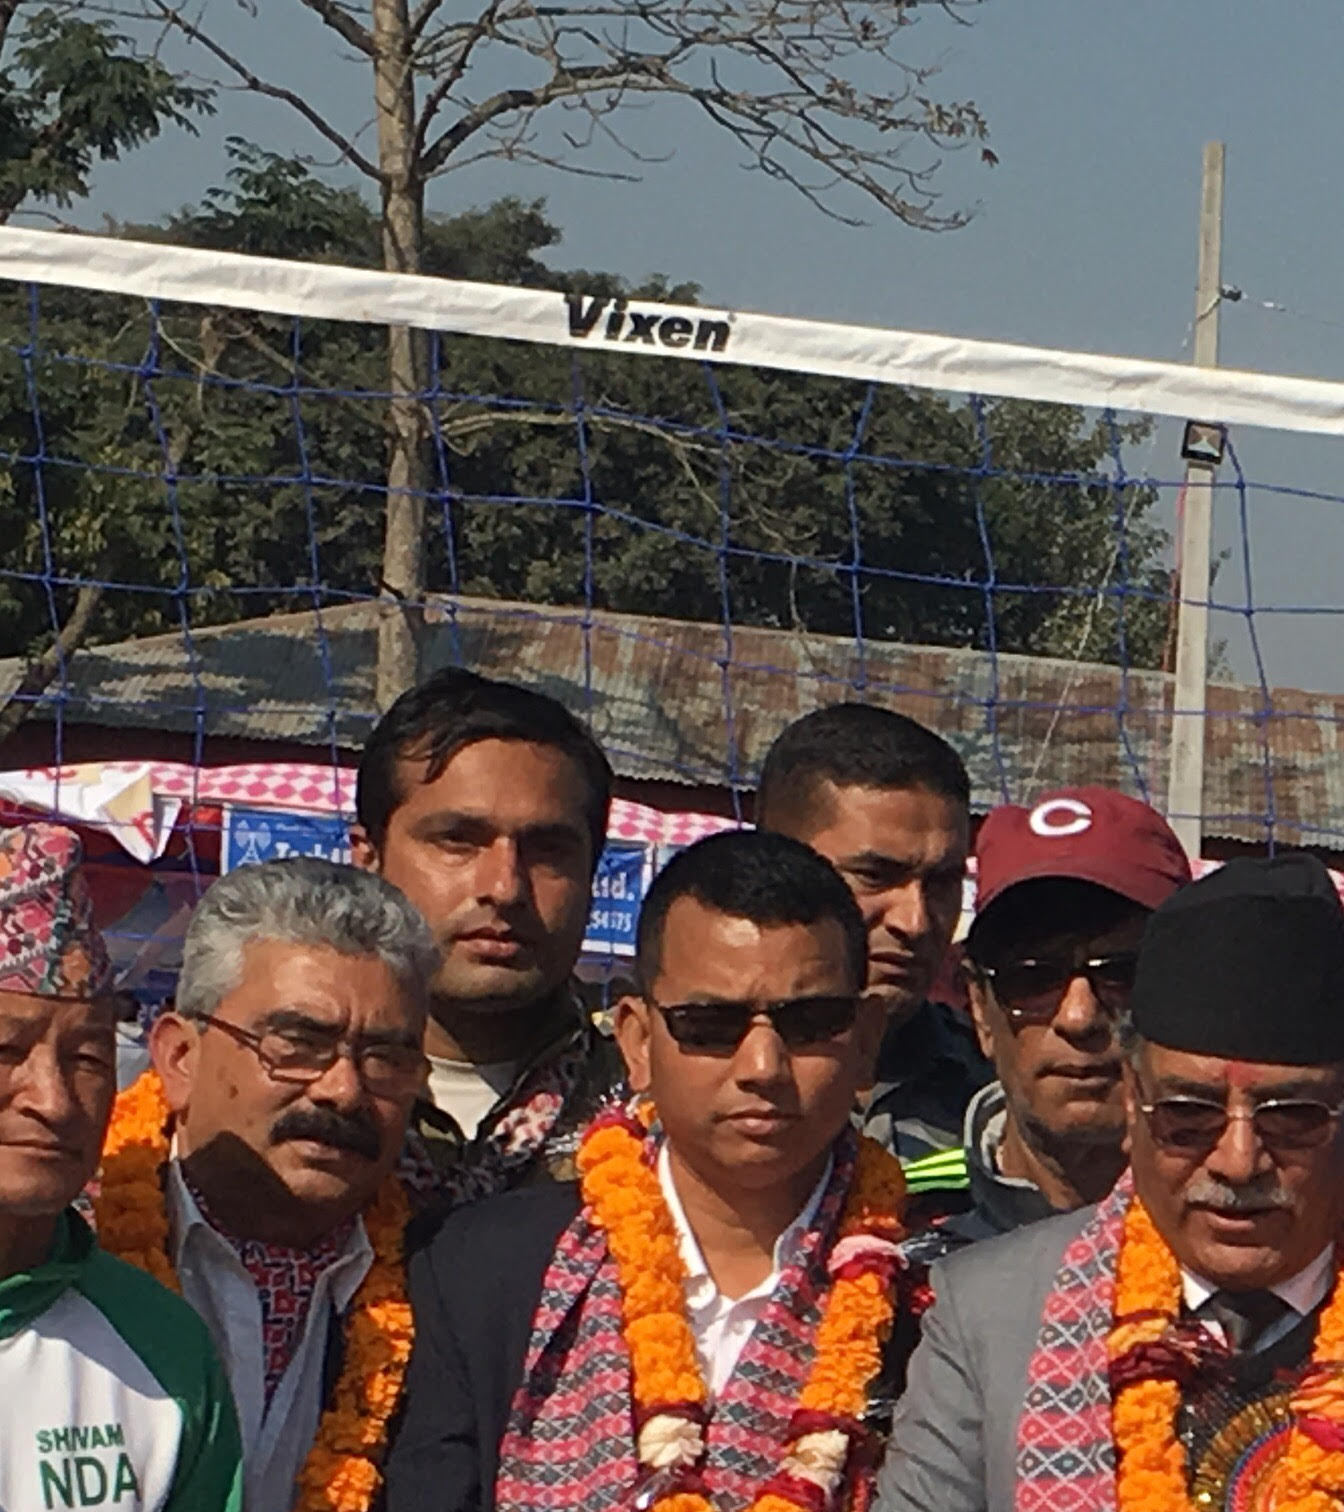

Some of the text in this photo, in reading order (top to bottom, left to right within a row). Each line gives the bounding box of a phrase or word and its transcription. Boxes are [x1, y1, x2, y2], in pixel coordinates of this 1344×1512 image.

[564, 294, 732, 352] Vixen
[1029, 798, 1092, 836] C
[36, 1423, 126, 1453] SHIVAM
[38, 1452, 142, 1510] NDA
